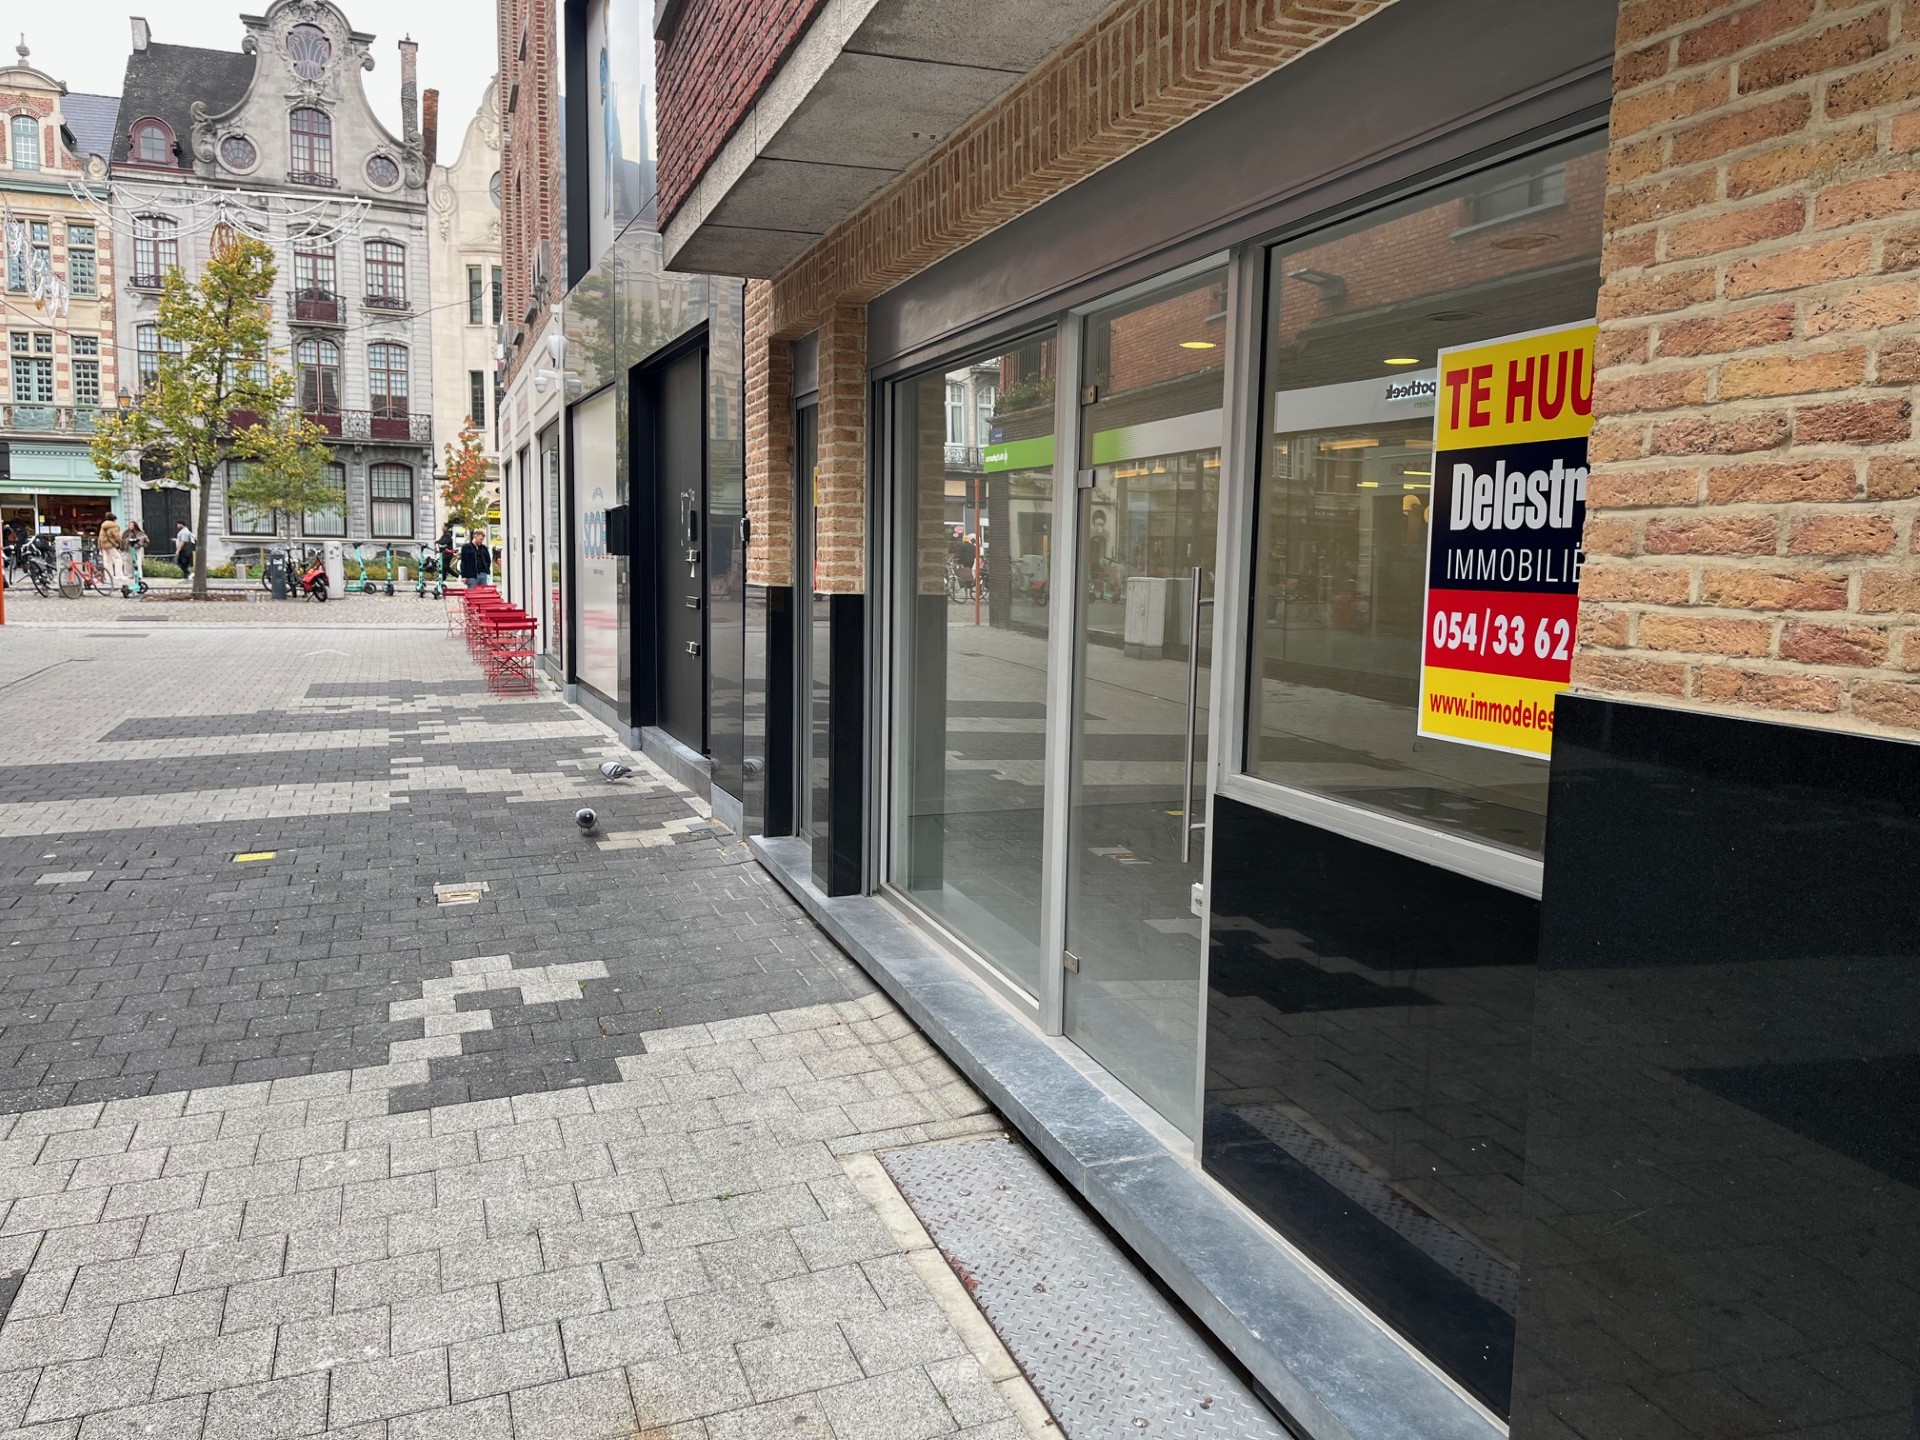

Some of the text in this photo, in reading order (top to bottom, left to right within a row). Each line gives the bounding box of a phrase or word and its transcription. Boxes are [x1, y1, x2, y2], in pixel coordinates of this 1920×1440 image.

[1446, 364, 1493, 430] TE
[1450, 458, 1588, 531] Delestr
[1432, 608, 1569, 661] 054/33 62
